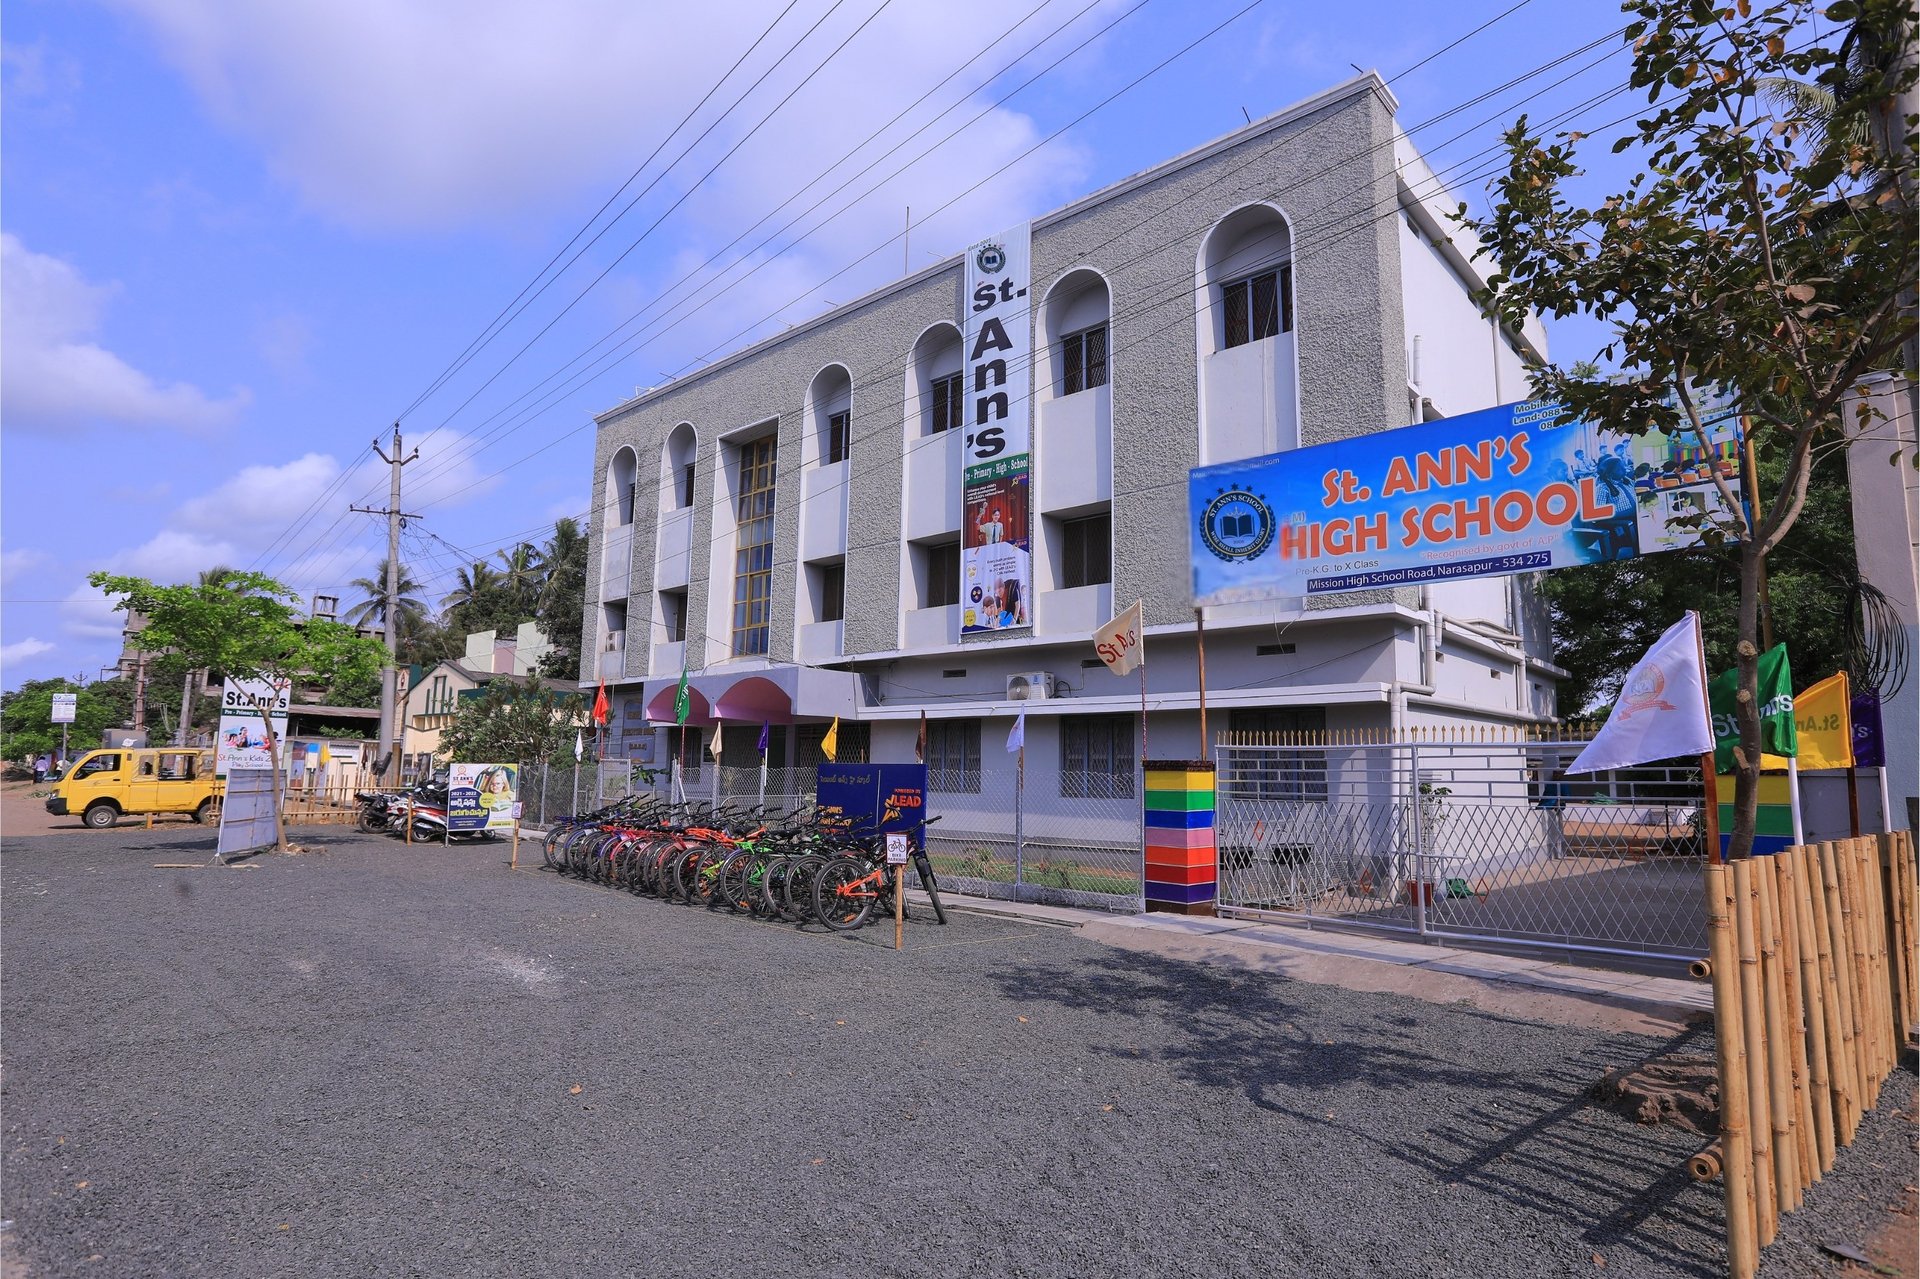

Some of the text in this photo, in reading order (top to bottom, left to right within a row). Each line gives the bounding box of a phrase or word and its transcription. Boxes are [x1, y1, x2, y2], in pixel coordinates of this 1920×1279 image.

[973, 277, 1027, 313] St.
[1513, 412, 1541, 426] Land:
[973, 467, 993, 479] Primary
[995, 461, 1008, 476] High
[1010, 456, 1029, 470] School
[1322, 431, 1533, 507] St. ANN'S
[1237, 494, 1265, 515] SCHOOL
[1280, 477, 1615, 561] HIGH SCHOOL
[1480, 545, 1495, 555] by
[1496, 541, 1520, 554] govt
[1522, 538, 1534, 548] of
[1308, 577, 1344, 591] Mission
[1346, 573, 1369, 588] High
[1371, 569, 1405, 584] School
[1407, 566, 1436, 580] Road,
[1437, 560, 1493, 577] Narasapur
[1502, 556, 1524, 569] 534
[1526, 553, 1549, 566] 275
[1334, 564, 1343, 572] to
[1345, 562, 1351, 570] X
[1353, 558, 1379, 569] Class
[249, 754, 264, 762] Kids
[894, 795, 922, 807] LEAD
